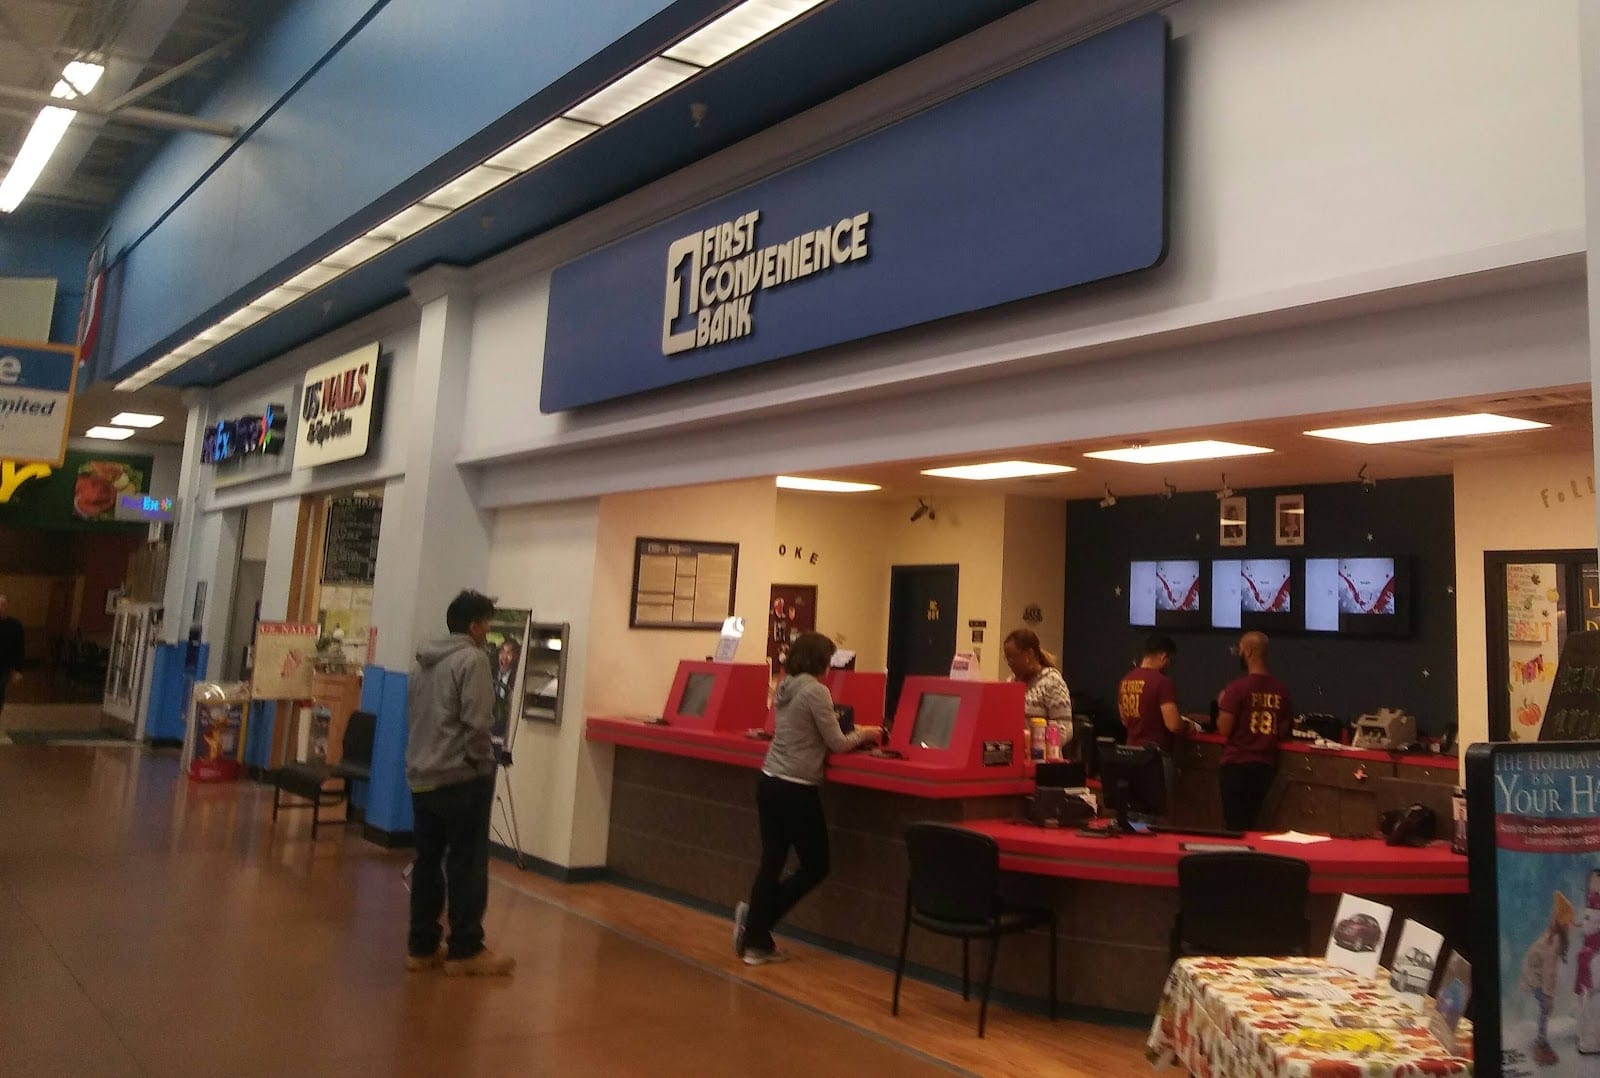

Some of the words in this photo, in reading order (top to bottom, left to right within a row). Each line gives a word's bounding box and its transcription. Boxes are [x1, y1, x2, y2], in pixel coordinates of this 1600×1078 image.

[700, 211, 870, 306] CONVENIENCE
[701, 209, 760, 268] FIRST
[697, 295, 753, 348] BANK
[321, 361, 369, 415] NAILS
[1495, 753, 1523, 771] THE
[1527, 752, 1591, 771] HOLIDAY
[1494, 774, 1564, 815] YOUR
